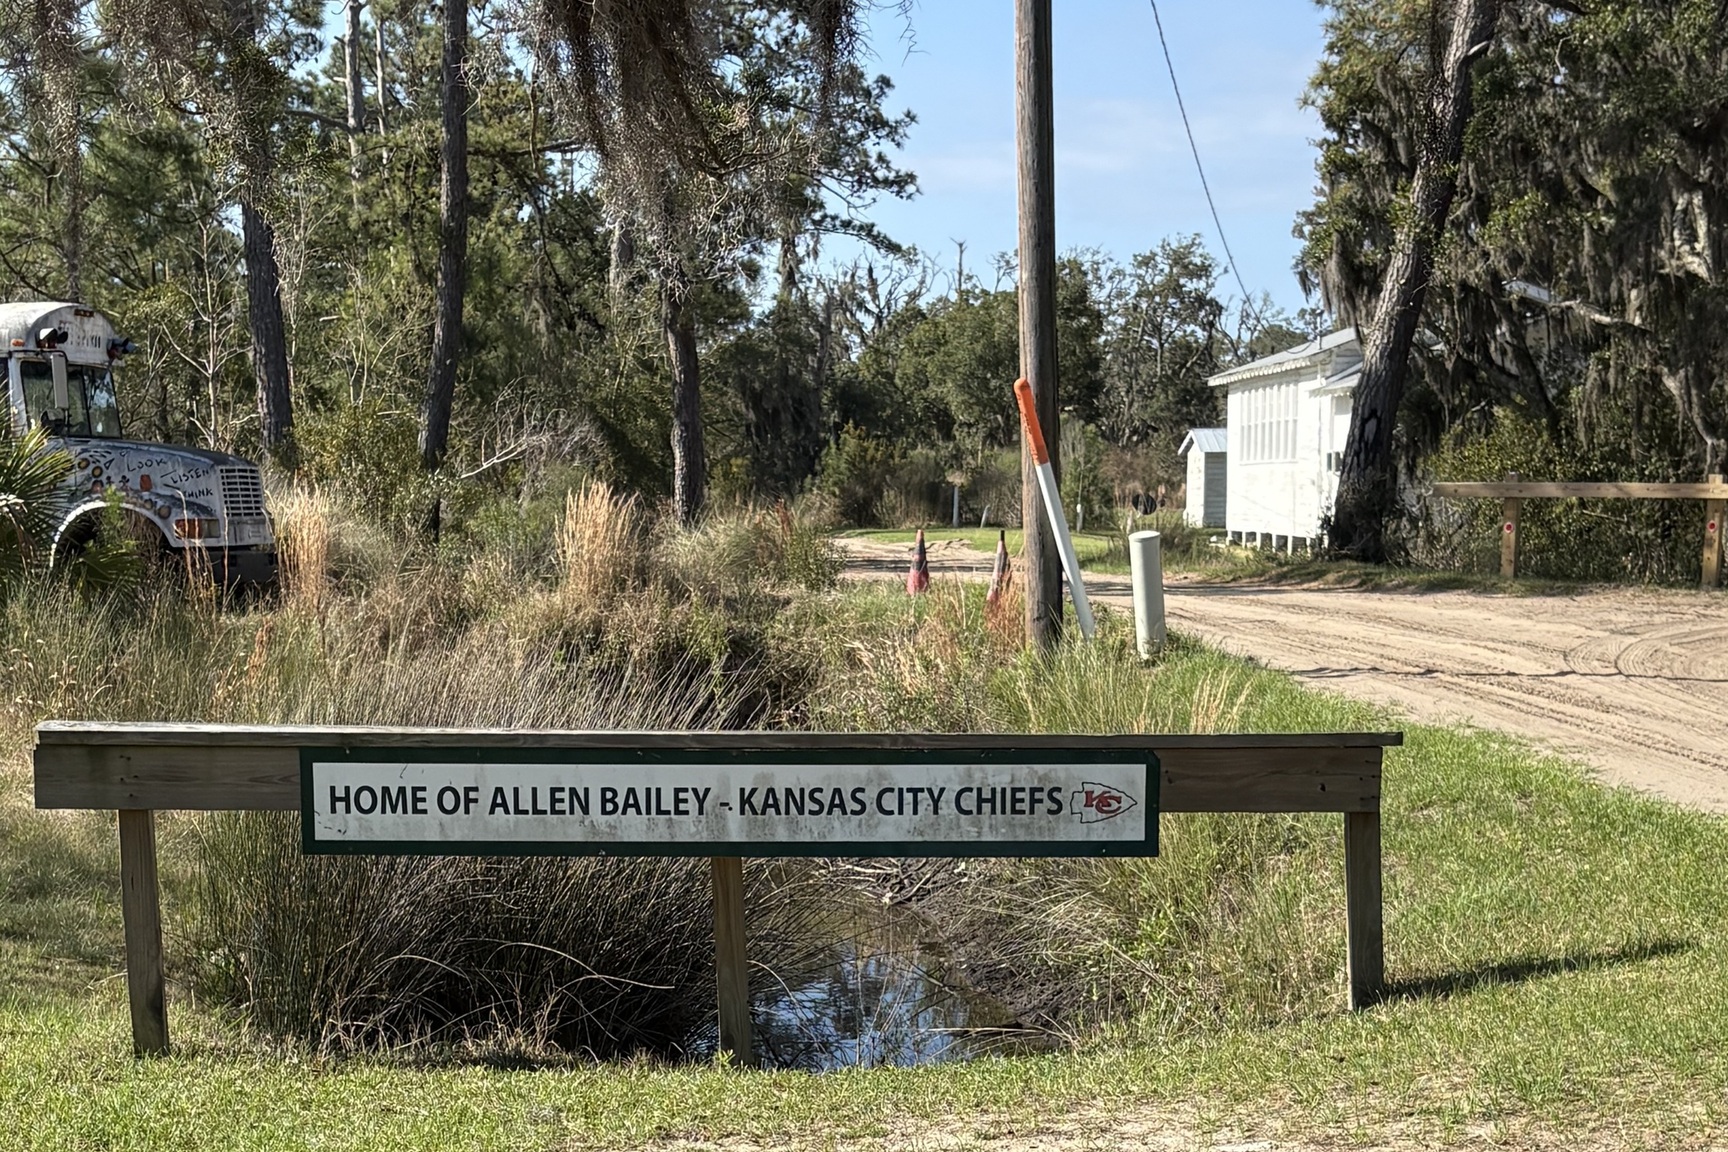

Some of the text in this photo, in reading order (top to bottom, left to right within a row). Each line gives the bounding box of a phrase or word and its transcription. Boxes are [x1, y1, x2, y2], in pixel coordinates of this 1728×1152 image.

[127, 458, 168, 472] LOOK
[171, 468, 210, 484] LISTEN
[329, 785, 427, 815] HOME
[437, 785, 479, 815] OF
[489, 786, 590, 816] ALLEN
[600, 786, 711, 816] BAILEY
[739, 786, 867, 816] KANSAS
[876, 786, 946, 816] CITY
[954, 786, 1063, 817] CHIEFS
[1083, 789, 1123, 814] KC
